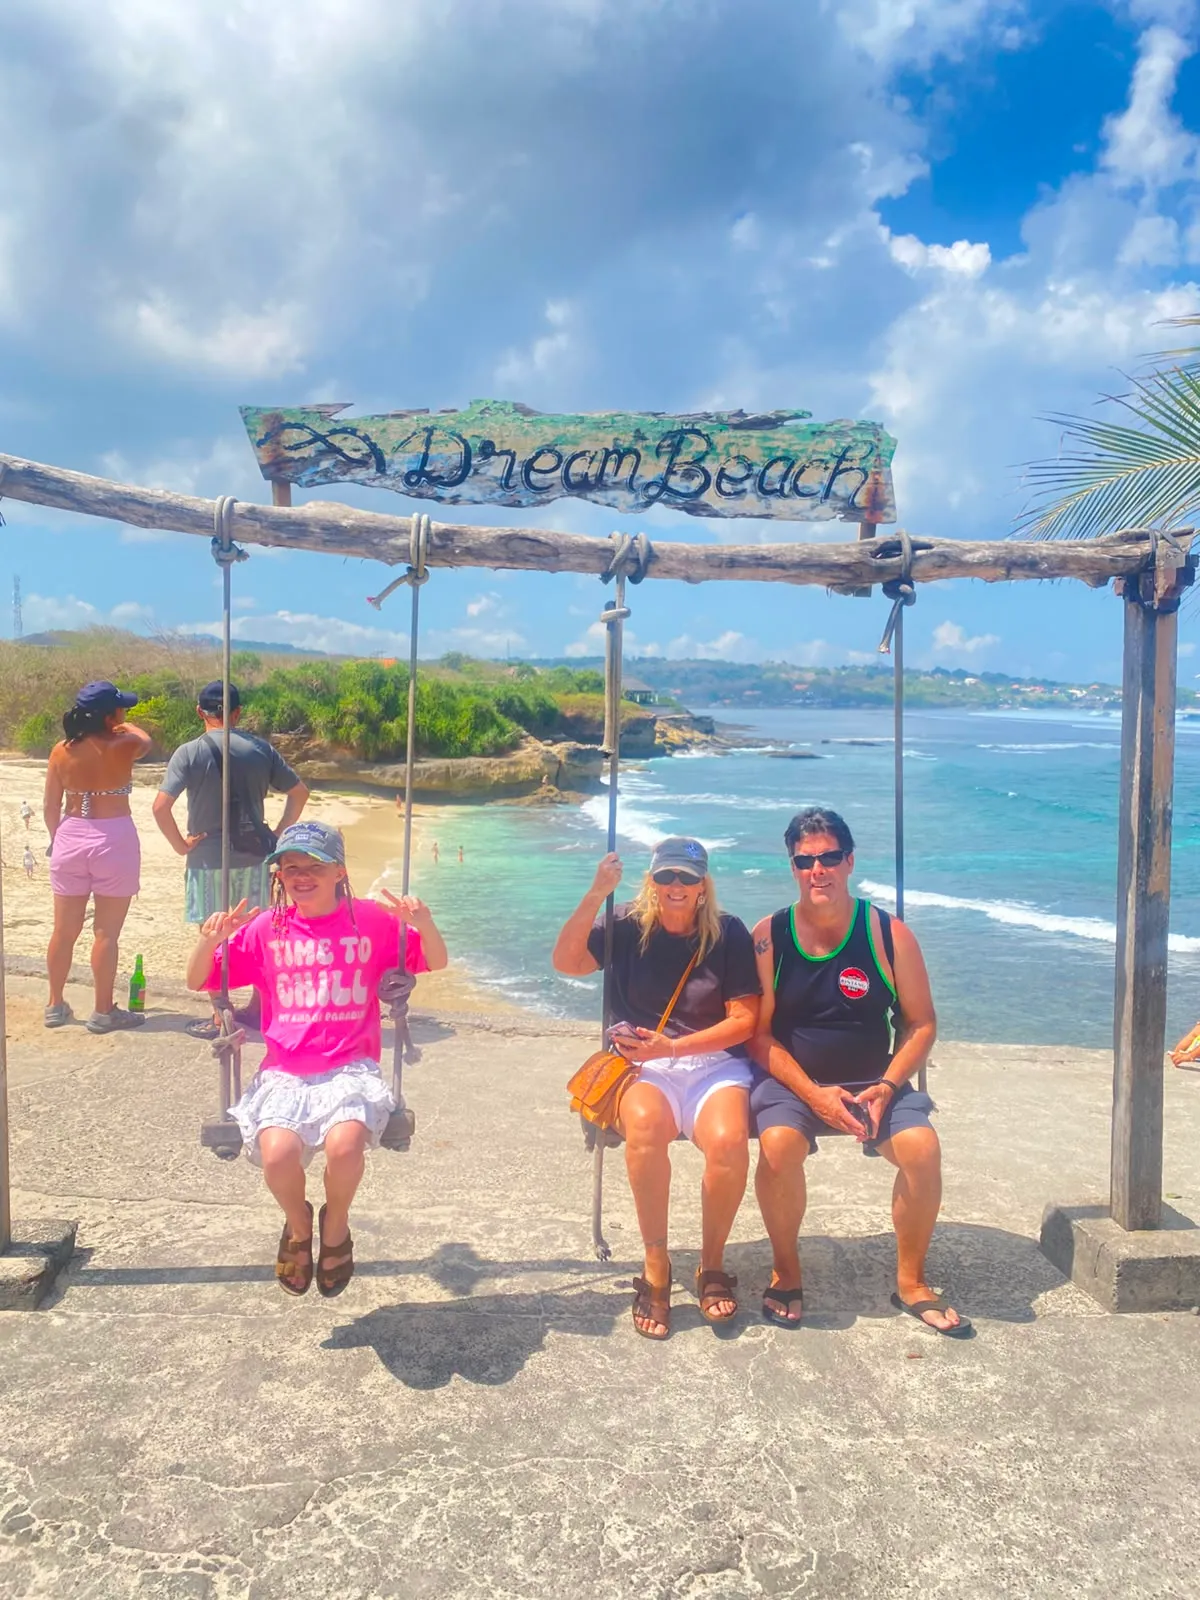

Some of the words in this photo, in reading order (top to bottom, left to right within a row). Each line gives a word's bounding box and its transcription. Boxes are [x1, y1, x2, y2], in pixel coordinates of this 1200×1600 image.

[391, 424, 643, 494] Dream
[642, 426, 877, 509] Beach
[268, 938, 334, 967] TIME
[340, 935, 372, 964] TO
[276, 969, 368, 1008] CHILL
